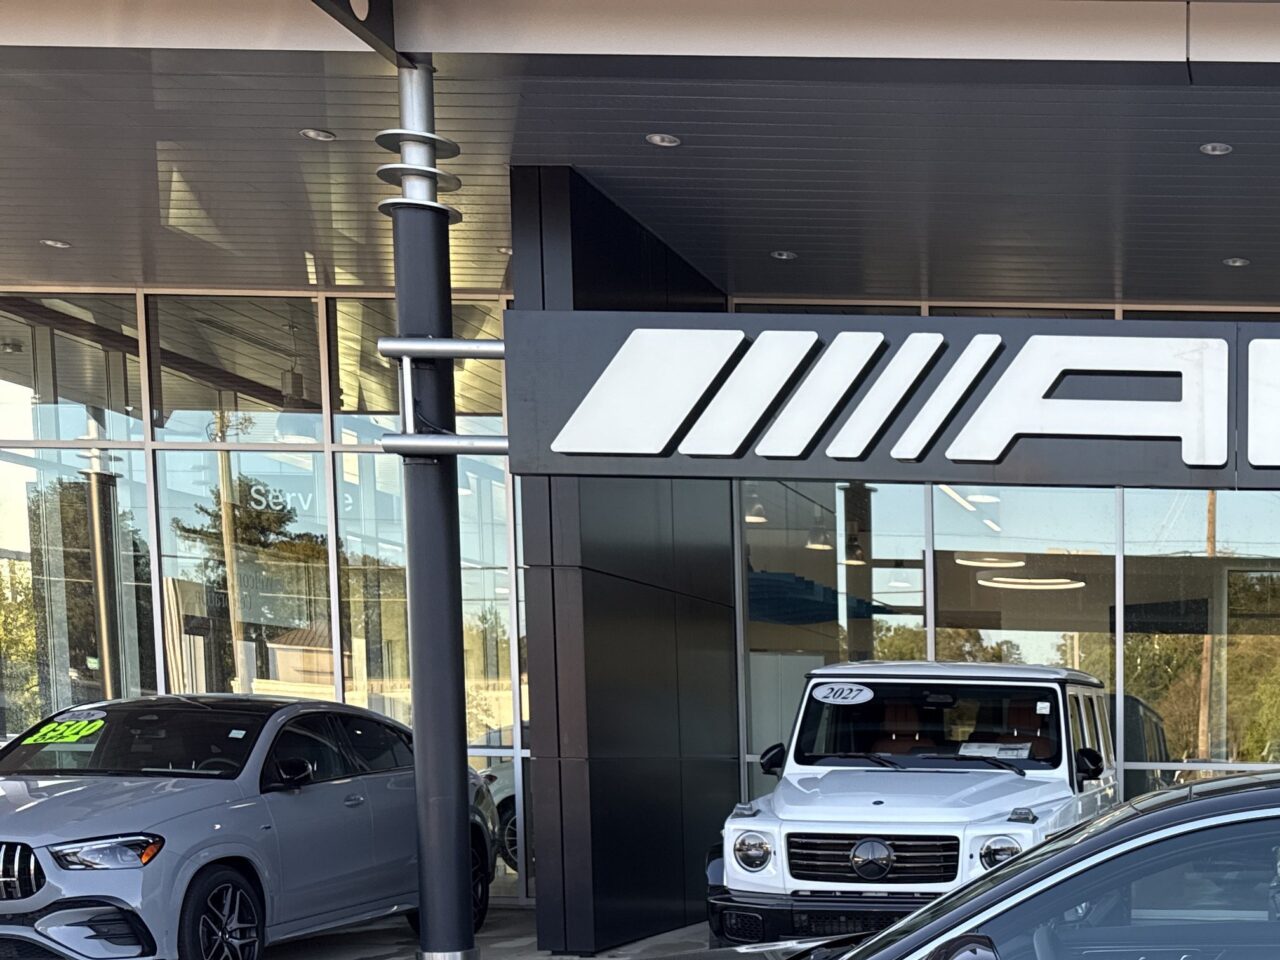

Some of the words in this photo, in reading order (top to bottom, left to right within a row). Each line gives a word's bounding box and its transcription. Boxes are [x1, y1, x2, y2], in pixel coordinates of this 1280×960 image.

[250, 484, 353, 512] Serve
[821, 686, 864, 700] 2027
[32, 719, 104, 738] 9500
